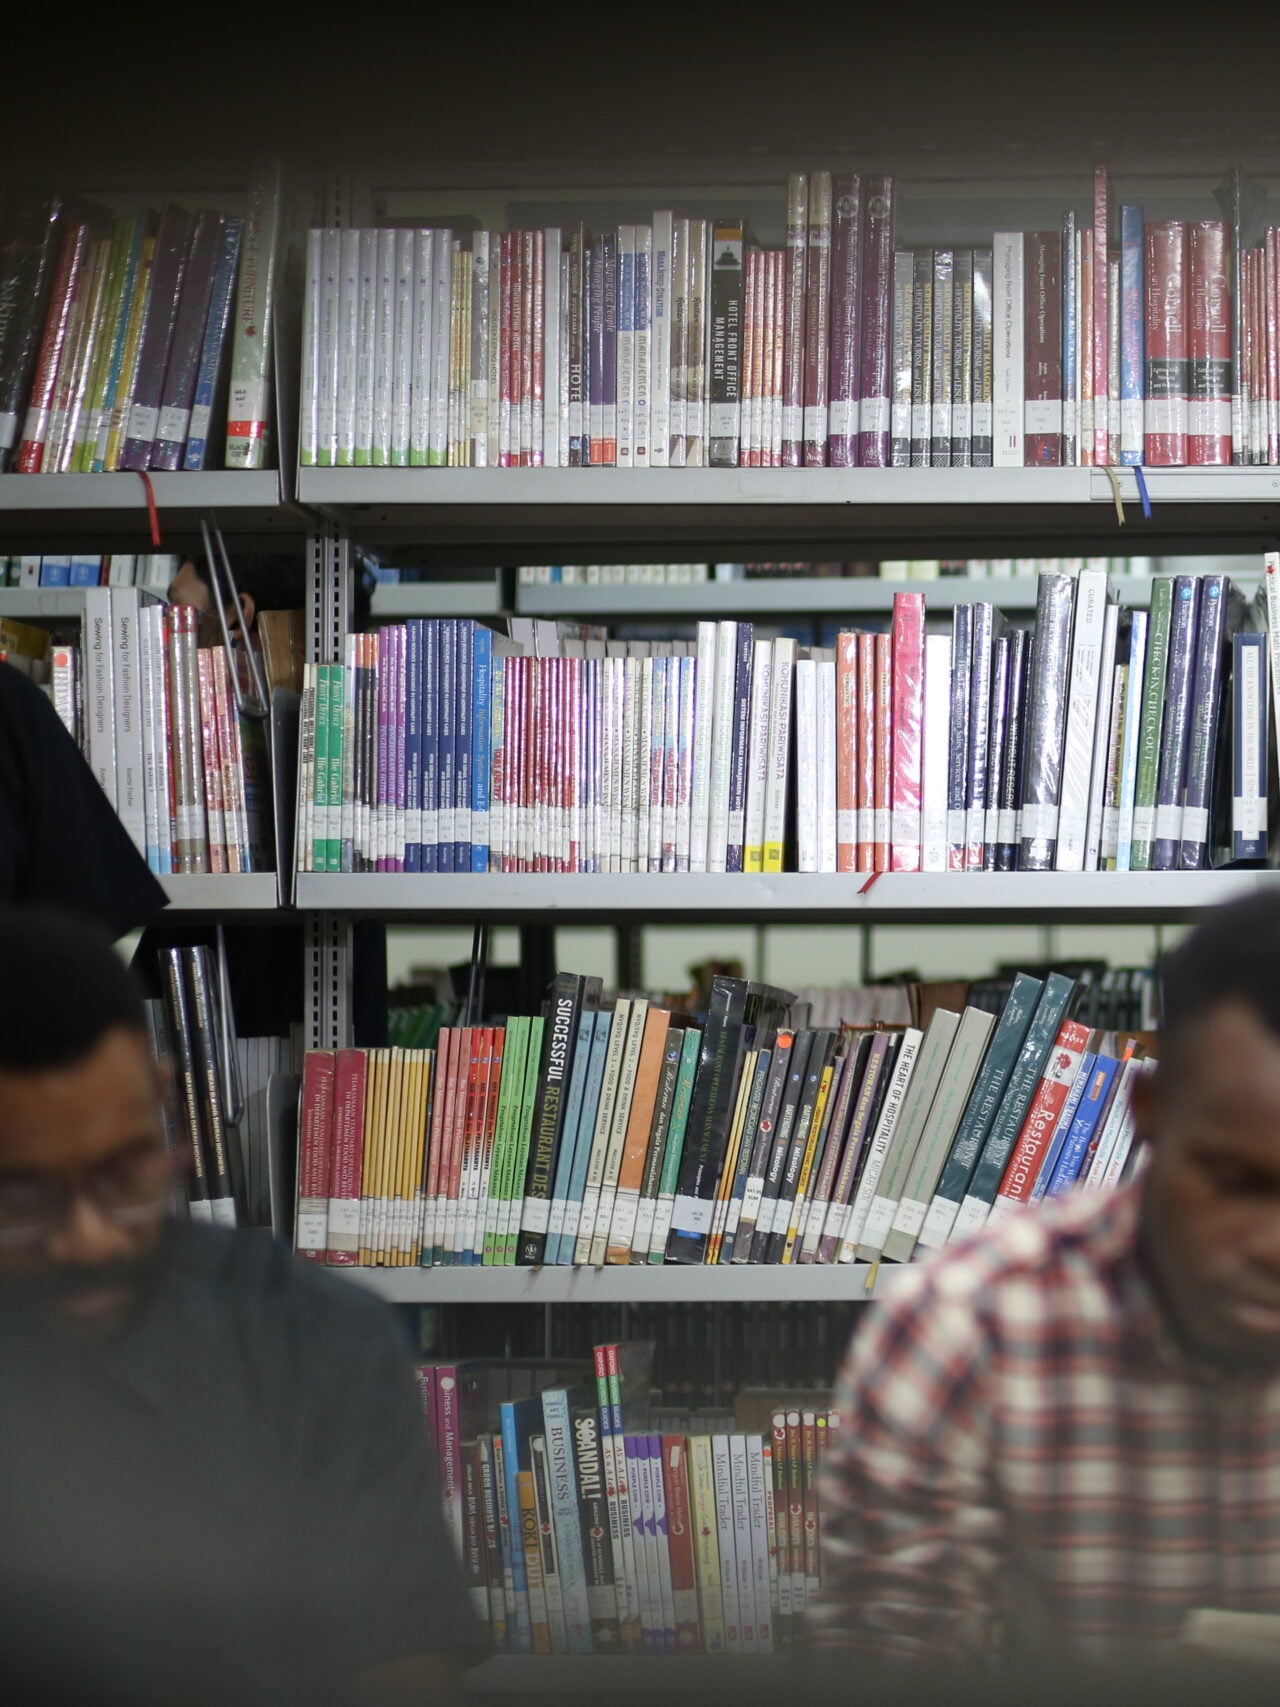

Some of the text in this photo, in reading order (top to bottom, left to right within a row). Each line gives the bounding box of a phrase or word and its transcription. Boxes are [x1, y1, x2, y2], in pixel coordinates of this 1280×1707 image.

[592, 259, 602, 332] Managing People
[604, 258, 615, 332] Managing People
[1002, 246, 1013, 358] Managing Front Office Operations
[1037, 244, 1046, 344] Managing Front Office Operations
[1150, 288, 1161, 331] Hospitality
[1164, 274, 1182, 334] Cornell
[1210, 274, 1226, 334] Cornell
[713, 317, 724, 380] MANAGEMENT
[726, 300, 738, 396] HOTEL FRONT OFFICE
[1085, 588, 1096, 624] CURATED
[1180, 600, 1189, 628] Pearson
[1208, 598, 1216, 626] Pearson
[1268, 596, 1278, 629] Business
[1272, 630, 1280, 650] Math
[93, 618, 106, 733] Sewing for Fashion Designers
[120, 617, 133, 732] Sewing for Fashion Designers
[474, 664, 488, 798] Hospitality Information Systems and
[738, 722, 746, 756] INFORMASI
[776, 662, 790, 780] KOMUNIKASI PARIWISATA
[1246, 651, 1256, 770] ALL THE KNOWLEDGE THE WORLD
[736, 757, 744, 794] MANAJEMEN
[756, 725, 767, 782] PARIWISATA
[953, 752, 963, 784] Services,
[1006, 724, 1017, 768] WITHOUT
[316, 772, 327, 803] Gabriel
[330, 773, 340, 804] Gabriel
[536, 998, 573, 1170] SUCCESSFUL RESTAURANT
[600, 1040, 622, 1136] LEVEL FOOD DRINK SERVICE
[616, 1040, 638, 1136] LEVEL FOOD DRINK SERVICE
[852, 1053, 880, 1136] RESTORAN dan Segala
[865, 1044, 916, 1185] THE HEART OF HOSPITALITY MICAH
[1058, 1072, 1088, 1130] MEMAHAMI TRAUMA
[1110, 1100, 1124, 1127] Panduan
[494, 1105, 506, 1168] Pengetahuan Layanan
[506, 1105, 518, 1168] Pengetahuan Layanan
[654, 1125, 665, 1146] Segala
[769, 1104, 795, 1183] BARTENDING Mixology
[786, 1104, 812, 1184] BARTENDING Mixology
[960, 1068, 1006, 1170] THE RESTAURANT
[992, 1066, 1038, 1169] THE RESTAURANT
[1062, 1136, 1080, 1162] Parents
[1098, 1128, 1116, 1158] Mendidik
[516, 1144, 527, 1196] Layanan Makanan
[1009, 1109, 1056, 1202] Restaurant
[1094, 1160, 1104, 1176] Anak
[596, 1352, 610, 1430] OXFORD REVISION GUIDES
[608, 1350, 622, 1428] OXFORD REVISION GUIDES
[444, 1432, 456, 1490] Management
[550, 1426, 569, 1500] BUSINESS
[574, 1418, 601, 1500] SCANDAL!
[750, 1452, 762, 1528] Mindful Trader
[610, 1502, 620, 1540] BUSINESS
[620, 1500, 632, 1538] BUSINESS
[715, 1454, 729, 1530] Mindful Trader
[732, 1454, 746, 1530] Mindful Trader
[522, 1508, 538, 1548] KOKI
